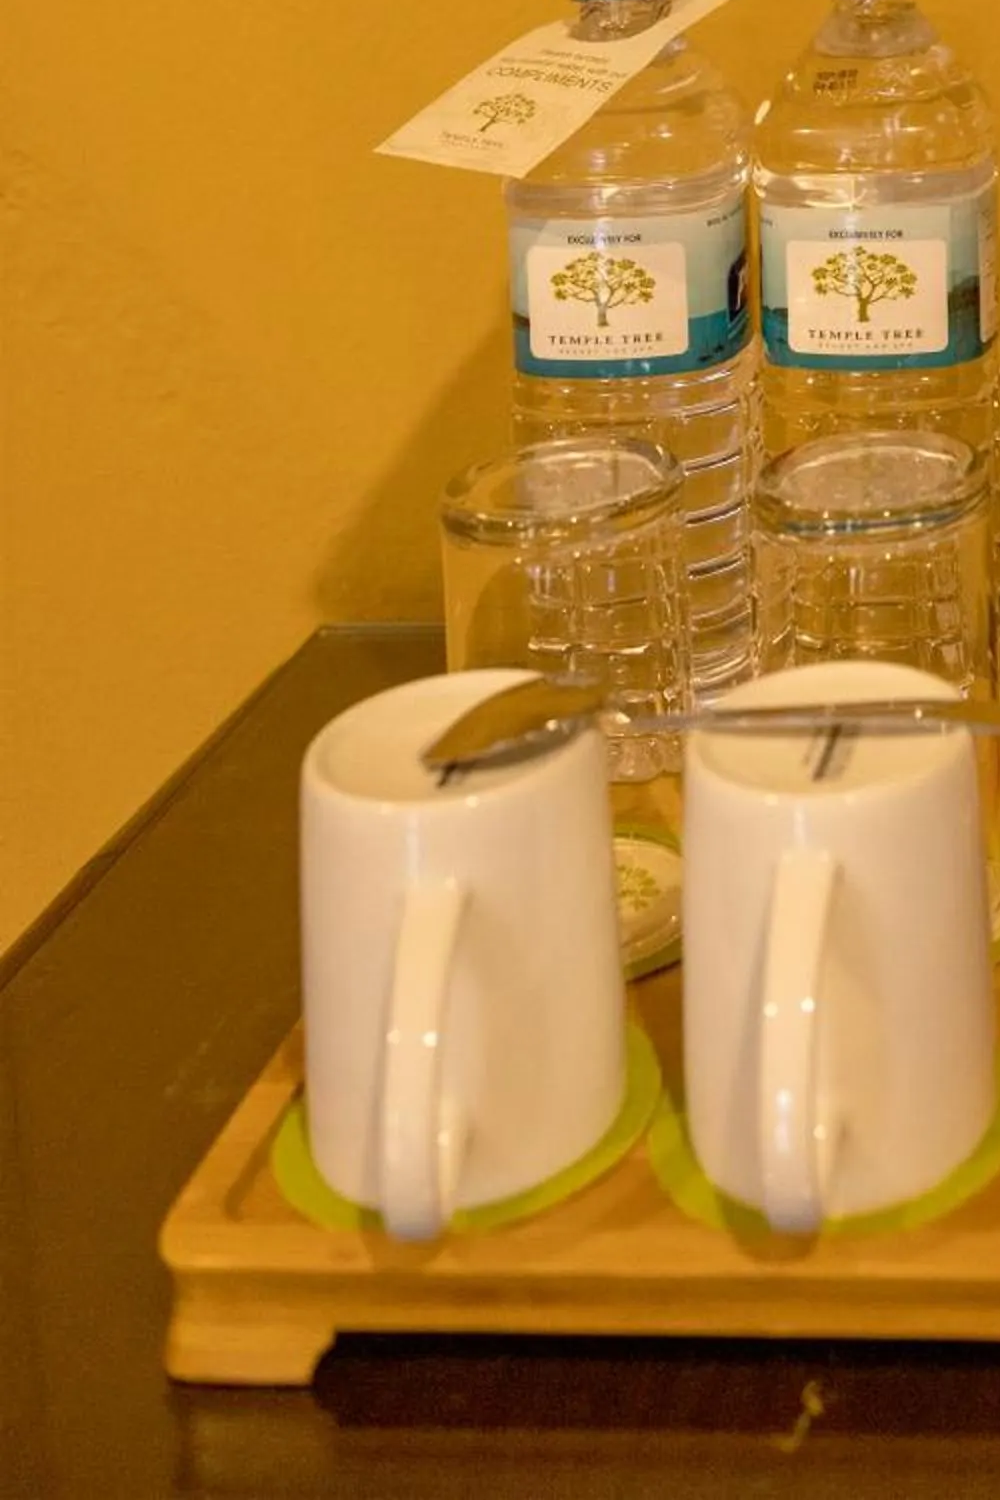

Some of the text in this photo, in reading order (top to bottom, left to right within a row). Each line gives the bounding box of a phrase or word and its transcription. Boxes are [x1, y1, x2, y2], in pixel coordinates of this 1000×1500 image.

[567, 234, 622, 245] EXCLUVELY
[885, 229, 904, 239] FOR
[548, 332, 664, 346] TEMPLE TREE
[808, 329, 924, 341] TEMPLE TREE
